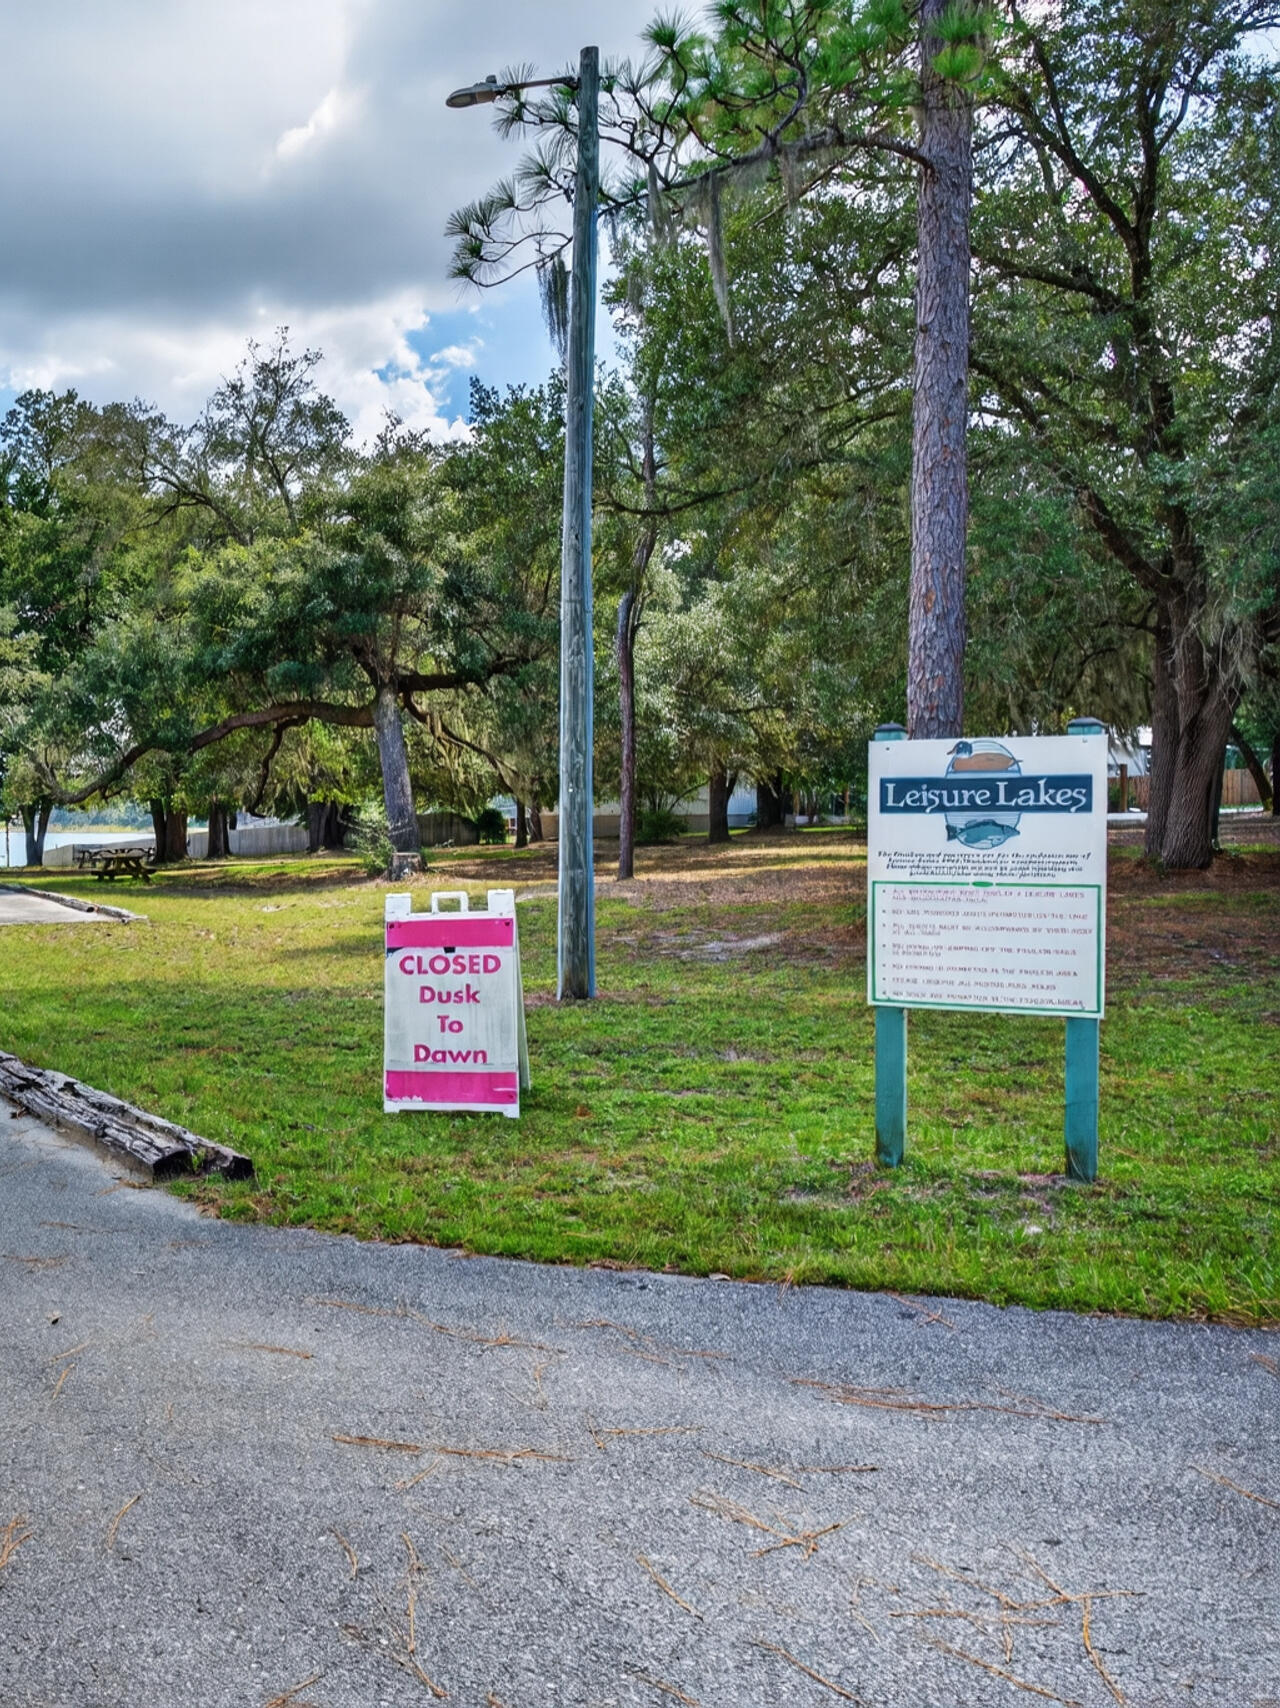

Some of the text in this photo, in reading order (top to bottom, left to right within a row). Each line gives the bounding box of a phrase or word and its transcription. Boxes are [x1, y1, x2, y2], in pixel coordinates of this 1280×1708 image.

[885, 777, 1088, 813] Leisure Lakes
[398, 954, 502, 975] CLOSED
[419, 983, 481, 1004] Dusk
[437, 1014, 464, 1034] To
[414, 1044, 488, 1064] Dawn
